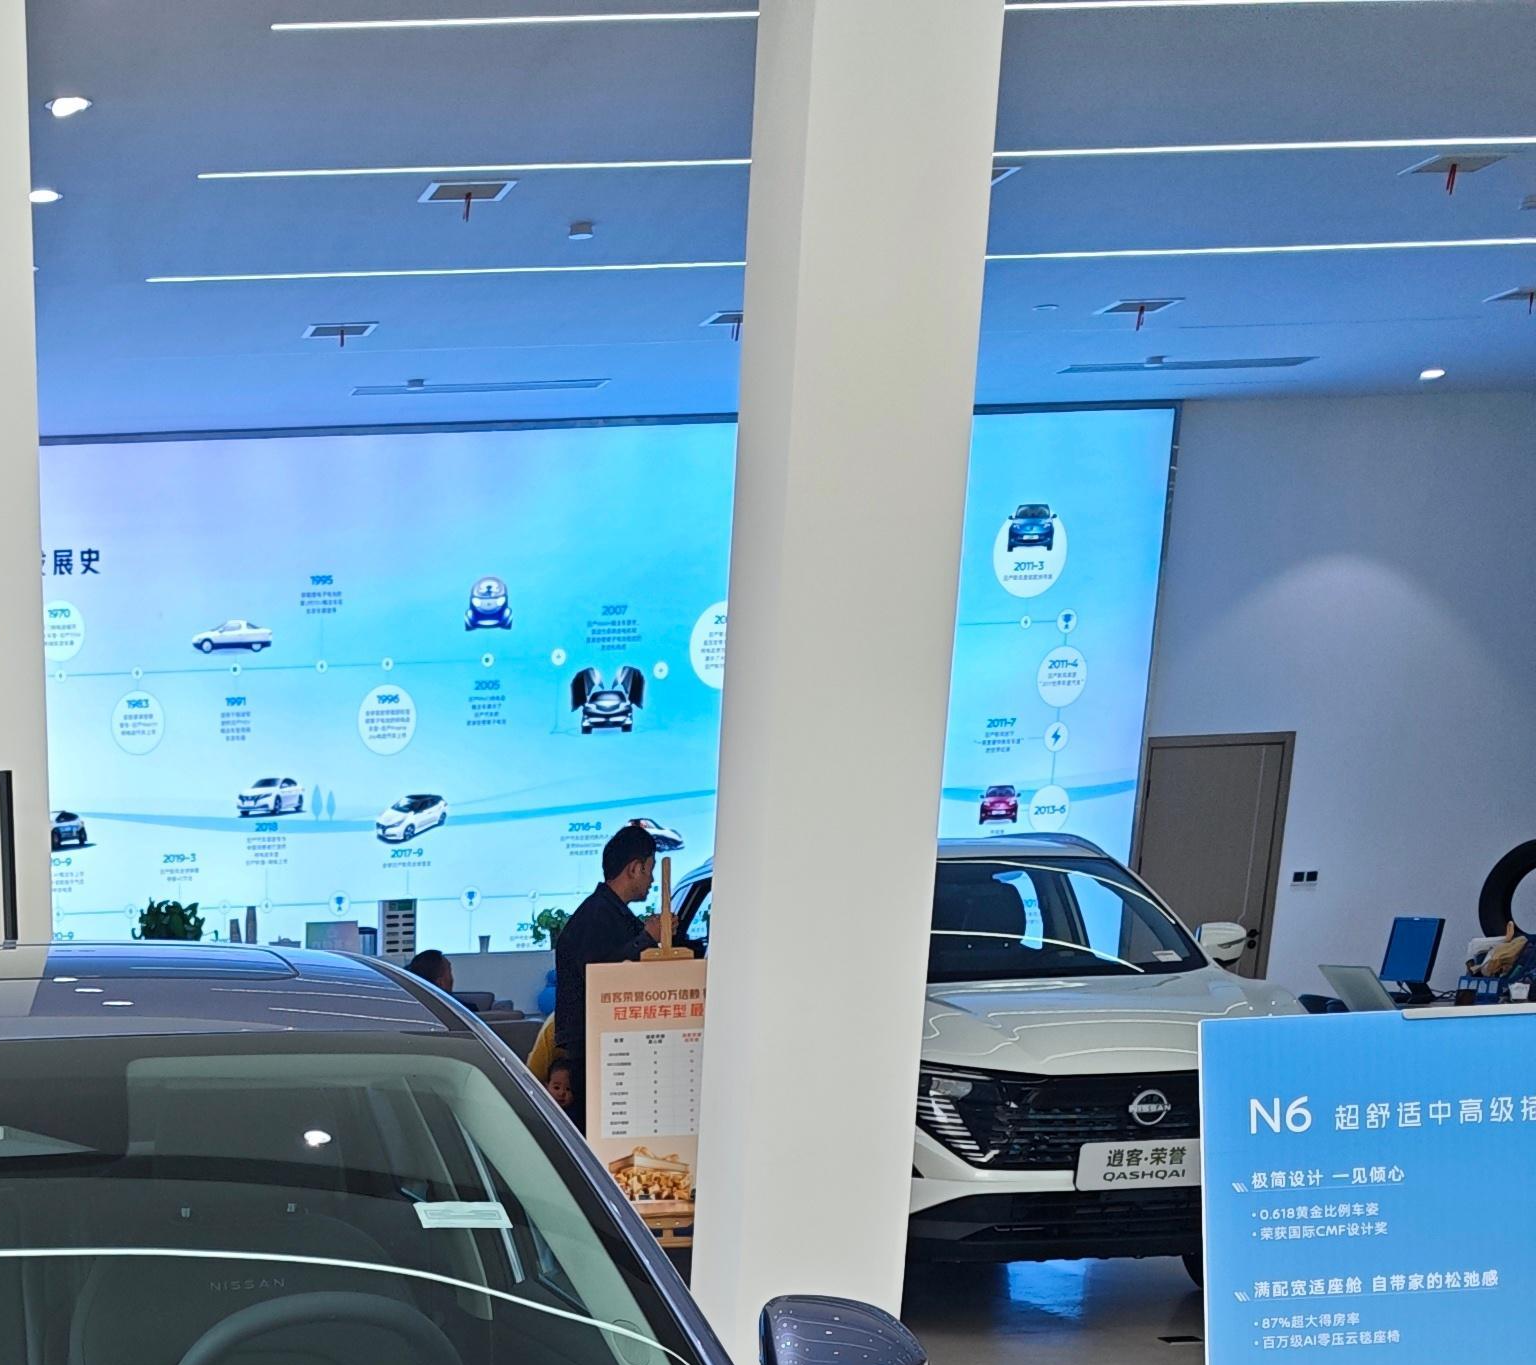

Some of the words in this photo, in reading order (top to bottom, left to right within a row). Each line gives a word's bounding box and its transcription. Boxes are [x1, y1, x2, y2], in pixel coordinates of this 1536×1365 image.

[47, 608, 71, 619] 1970
[601, 604, 628, 616] 2007
[474, 679, 501, 691] 2005
[376, 694, 400, 704] 1996
[1033, 805, 1066, 815] 2013-6
[163, 853, 197, 863] 2019-3
[390, 848, 424, 858] 2017-9
[1250, 1096, 1312, 1134] N6
[1103, 1169, 1186, 1182] QASHQAI
[1251, 1169, 1324, 1190] 极简设计
[1332, 1165, 1405, 1184] 一见倾心
[1259, 1202, 1380, 1220] 0.618黄金比例车姿
[1260, 1222, 1388, 1241] 荣获国际CMF设计奖
[1254, 1276, 1362, 1299] 满配宽适座舱
[1372, 1269, 1499, 1293] 自带家的松弛感
[1261, 1312, 1360, 1329] 87%超大得房率
[1263, 1330, 1401, 1349] 百万级AI零压云毯座椅
